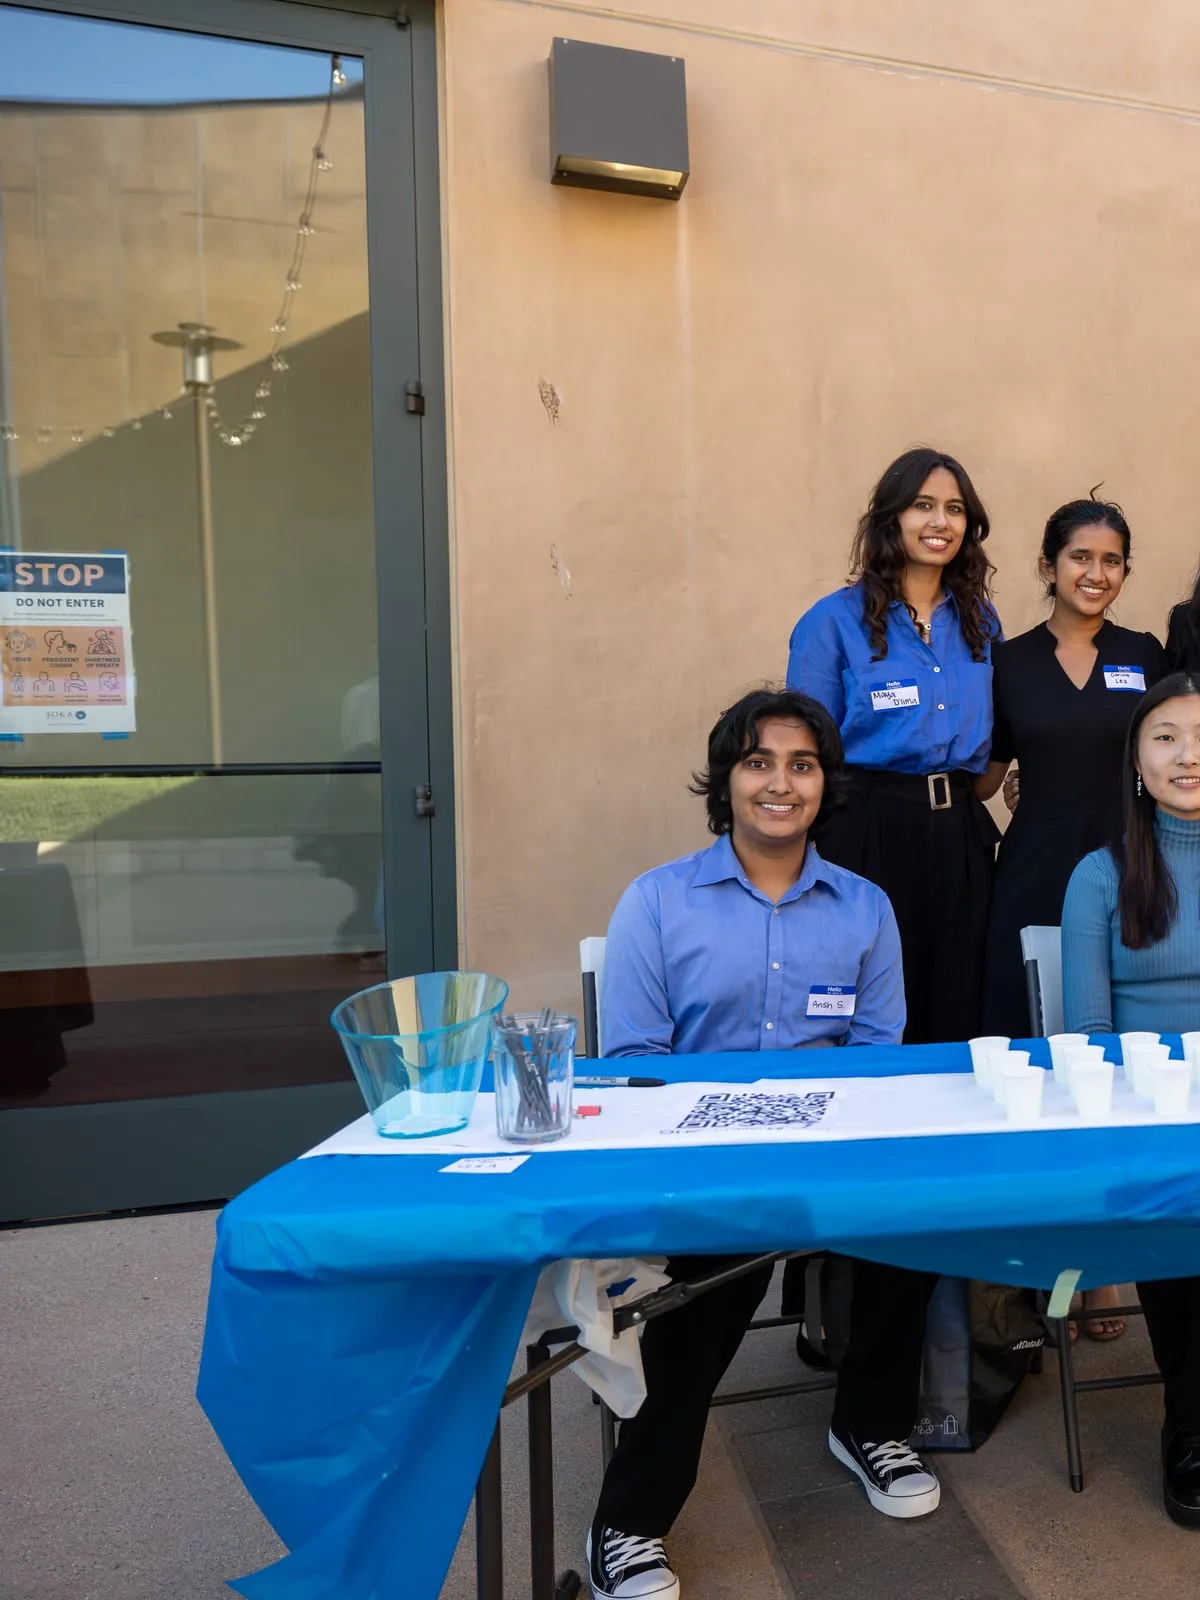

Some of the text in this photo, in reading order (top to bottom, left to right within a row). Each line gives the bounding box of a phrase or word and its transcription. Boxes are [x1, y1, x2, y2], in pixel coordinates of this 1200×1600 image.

[15, 563, 104, 587] STOP
[16, 598, 105, 608] DO NOT ENTER
